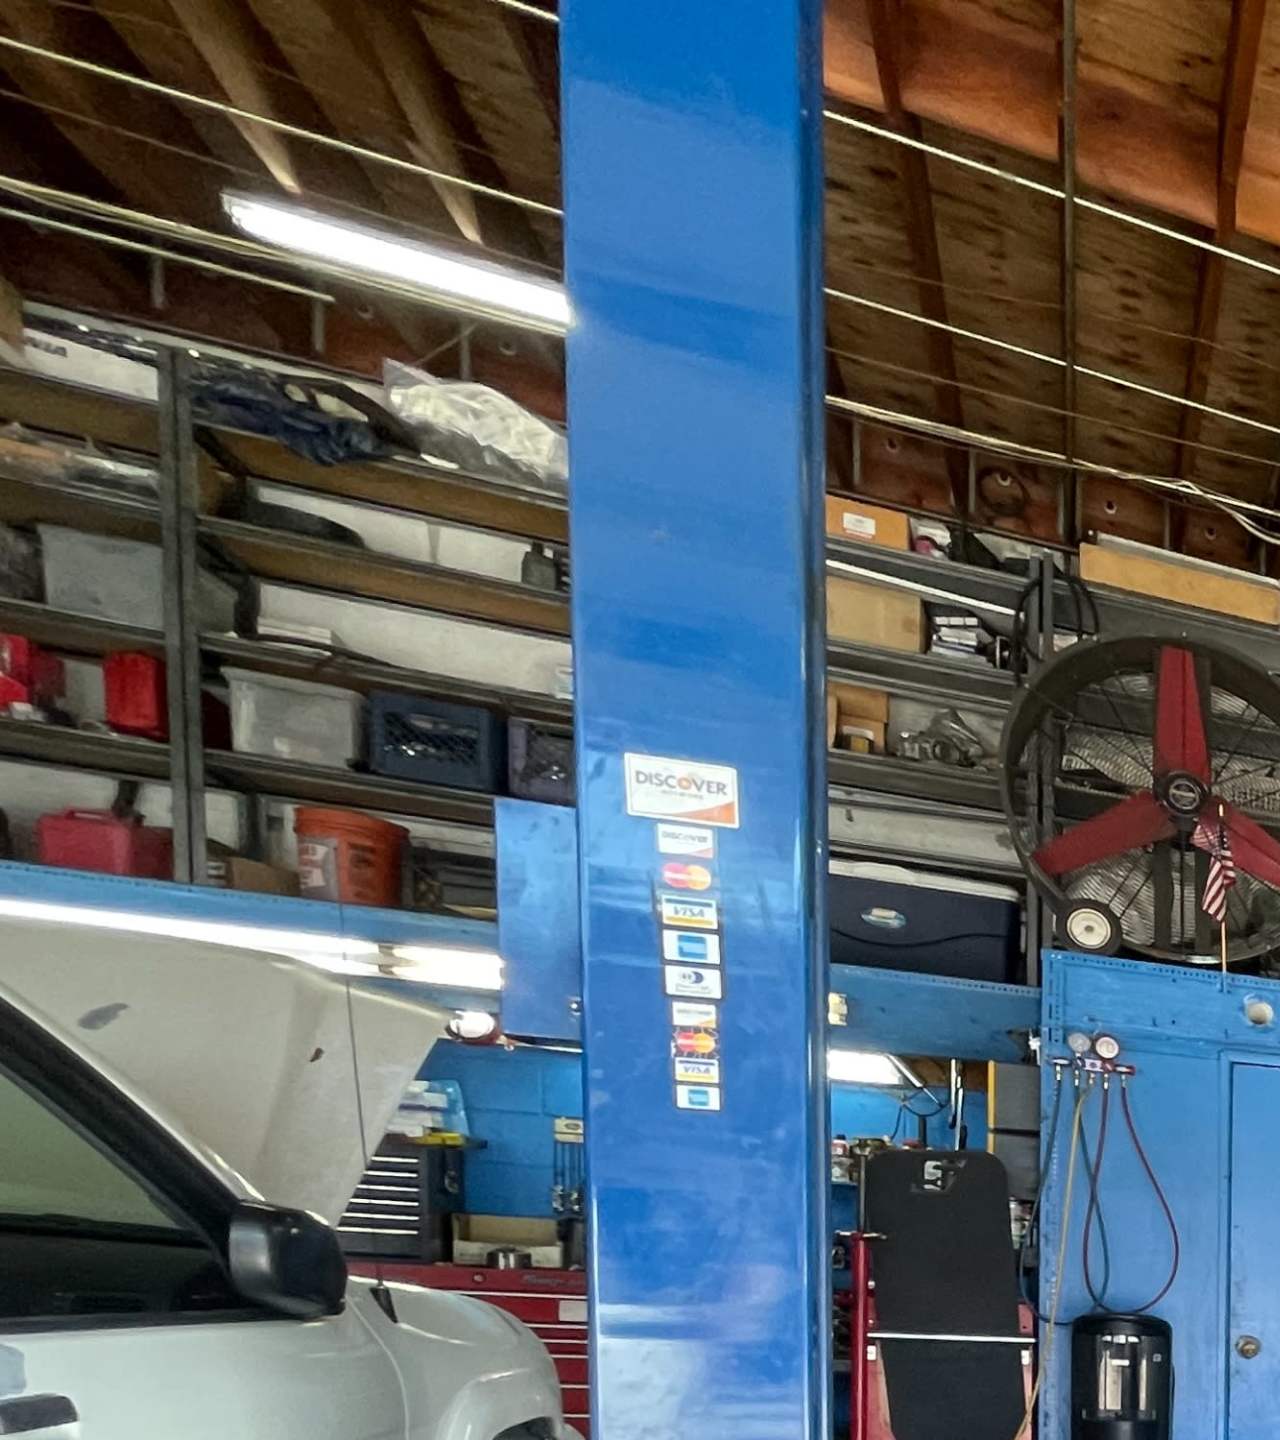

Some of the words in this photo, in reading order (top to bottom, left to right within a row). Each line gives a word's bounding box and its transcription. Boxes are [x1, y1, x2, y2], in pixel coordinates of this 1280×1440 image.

[635, 770, 728, 796] DISCOVER
[673, 906, 705, 918] VISA
[683, 1066, 711, 1074] VISA
